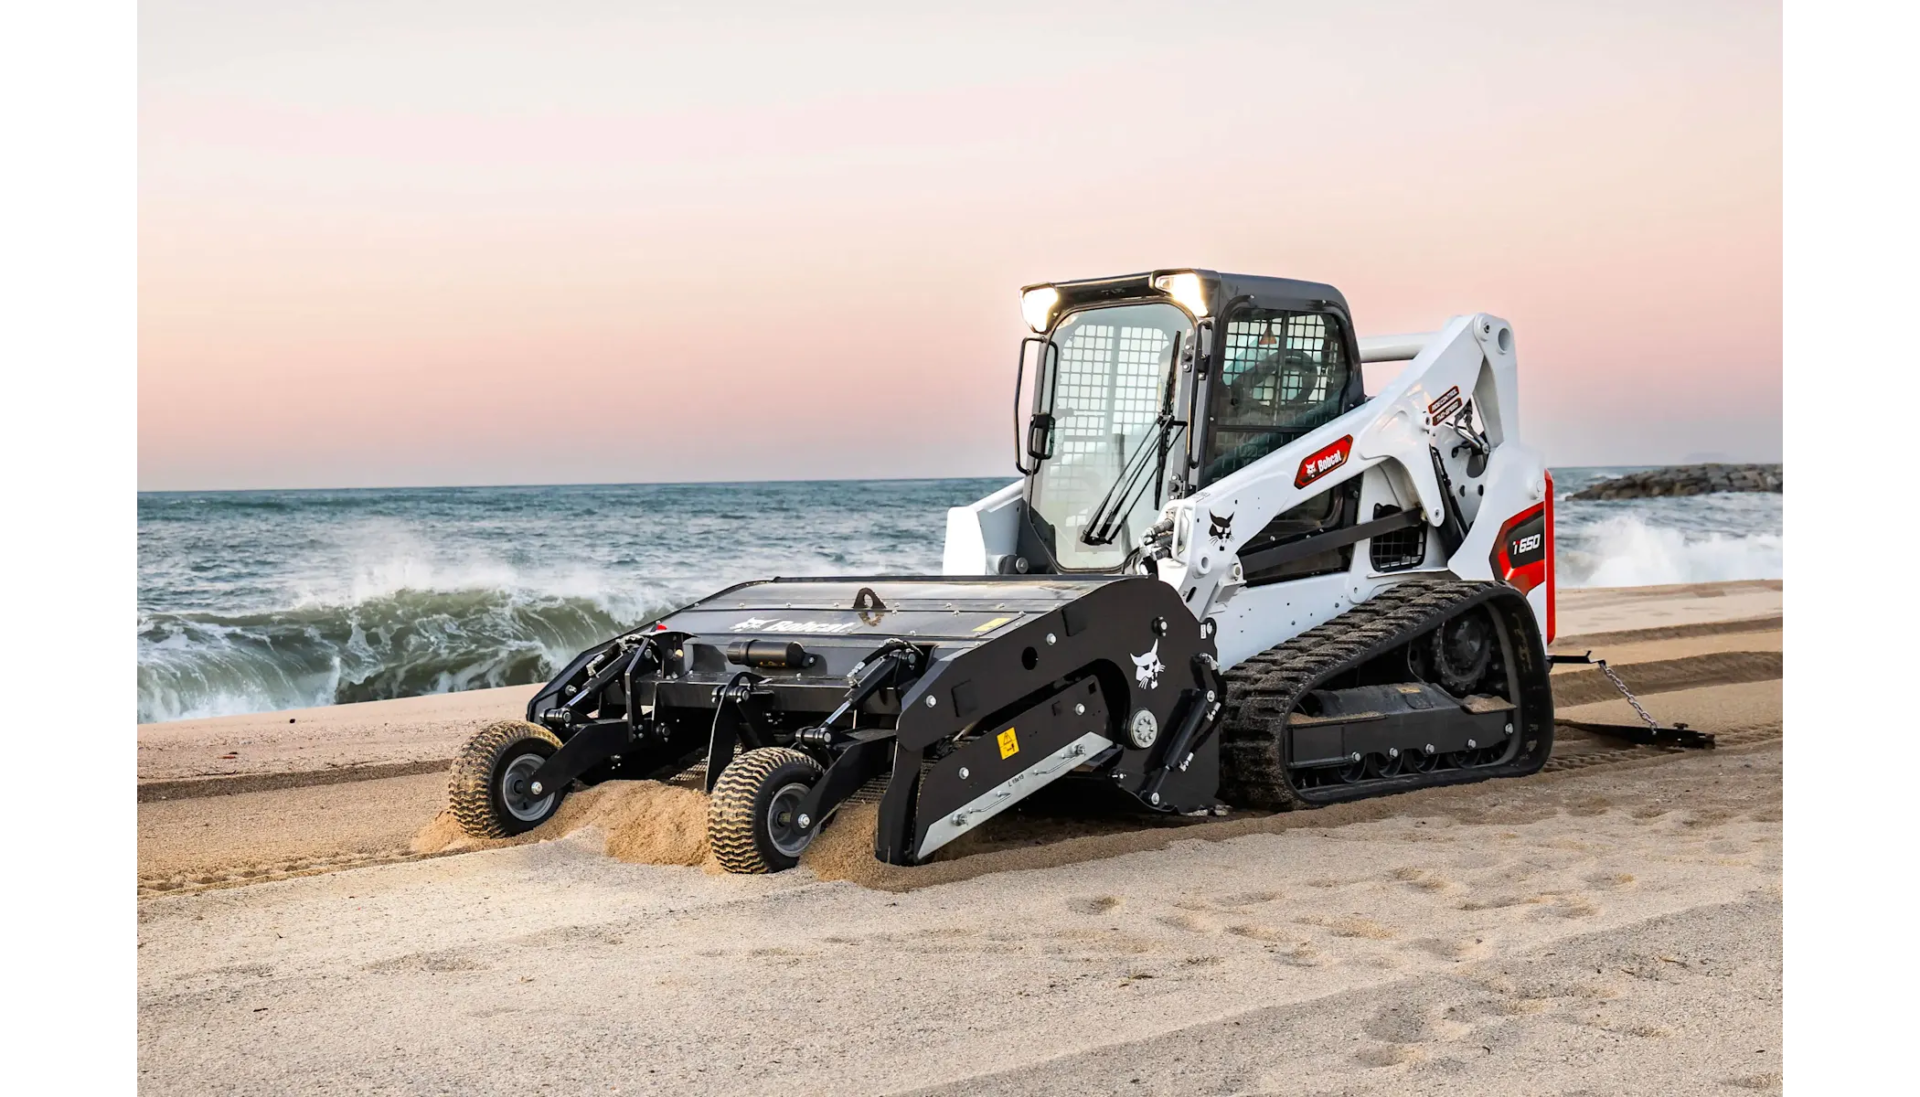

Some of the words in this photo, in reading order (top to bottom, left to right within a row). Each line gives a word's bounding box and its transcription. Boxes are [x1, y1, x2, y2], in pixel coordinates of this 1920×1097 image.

[1317, 449, 1342, 473] Bobcat
[1512, 533, 1541, 556] T650
[761, 620, 855, 633] Bobcat
